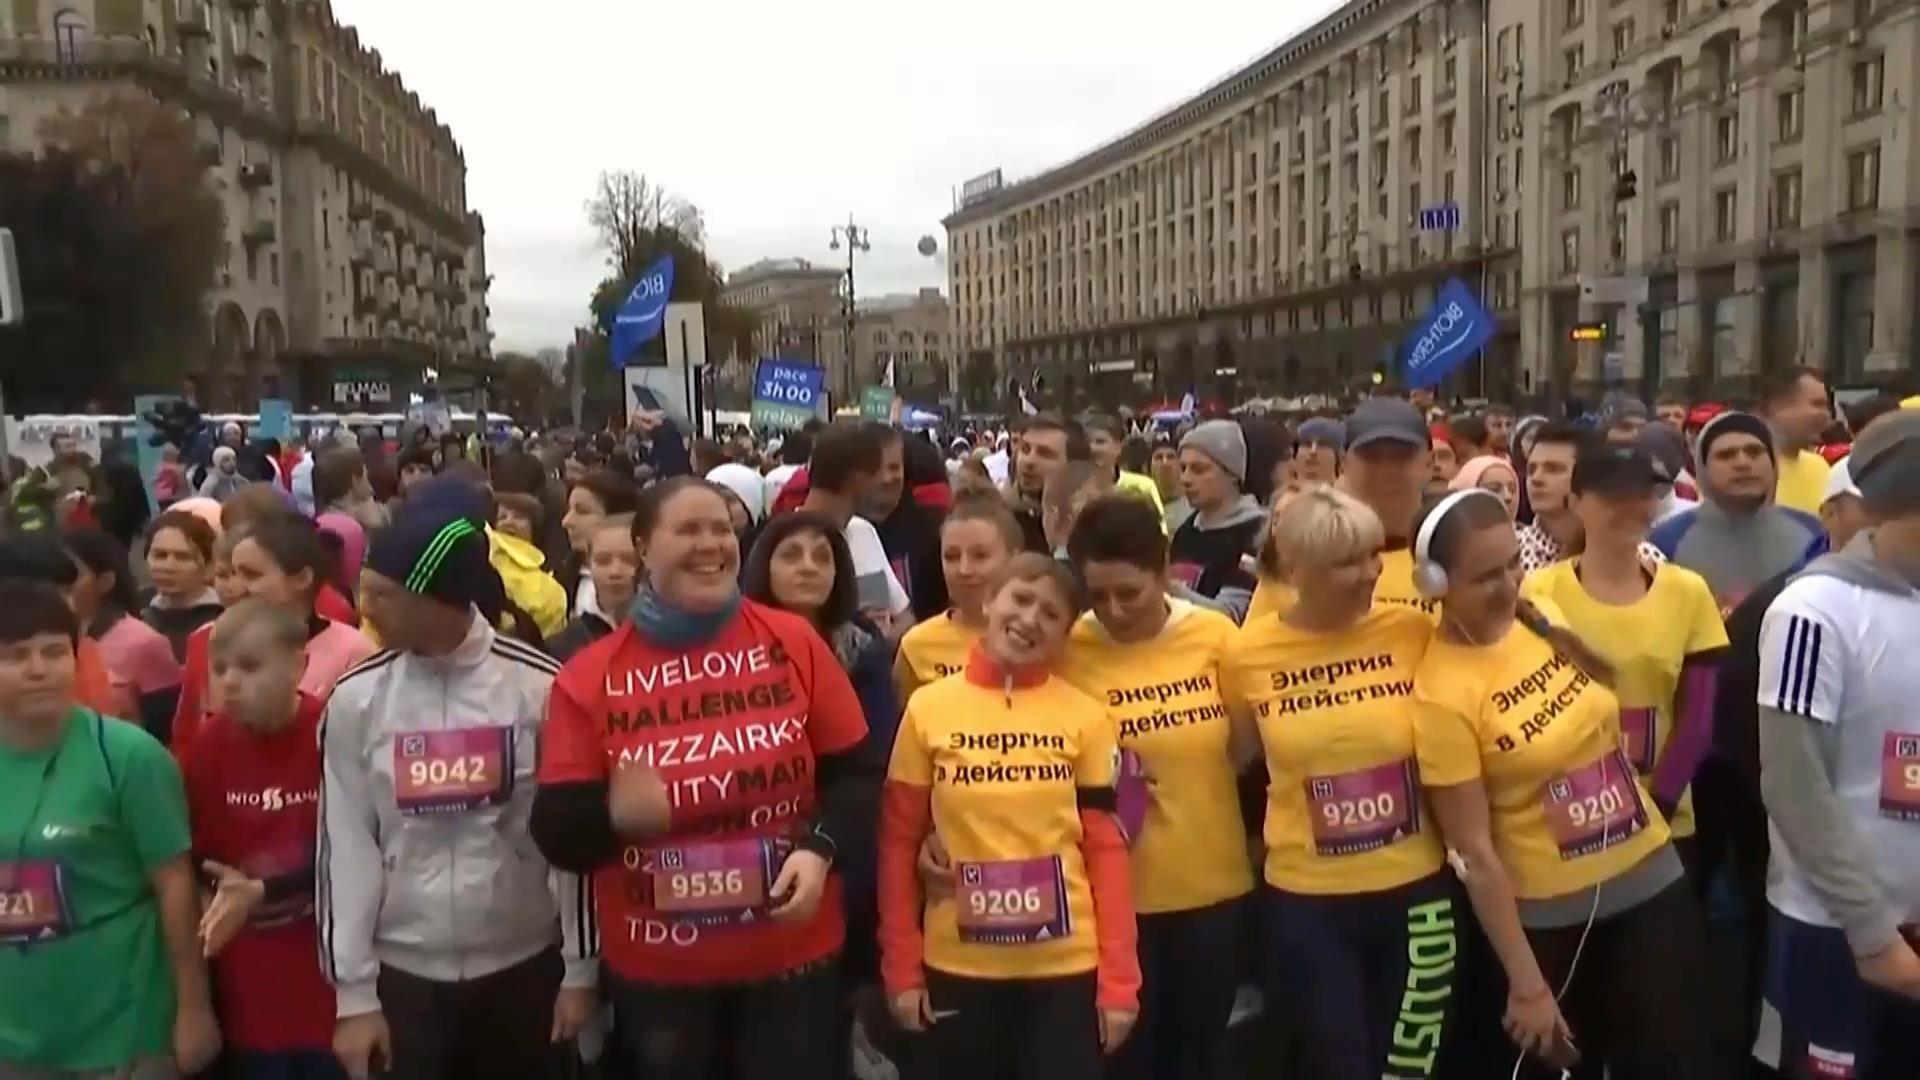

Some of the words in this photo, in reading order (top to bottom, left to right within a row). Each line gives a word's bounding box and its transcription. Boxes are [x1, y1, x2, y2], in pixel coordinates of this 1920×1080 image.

[774, 366, 807, 383] pace
[1270, 652, 1394, 691] Энергия
[1106, 674, 1212, 707] Энергия
[950, 732, 1065, 755] Энергия
[410, 756, 487, 787] 9042
[1323, 793, 1394, 827] 9200
[1568, 784, 1624, 827] 9201
[671, 868, 744, 899] 9536
[970, 886, 1041, 916] 9206
